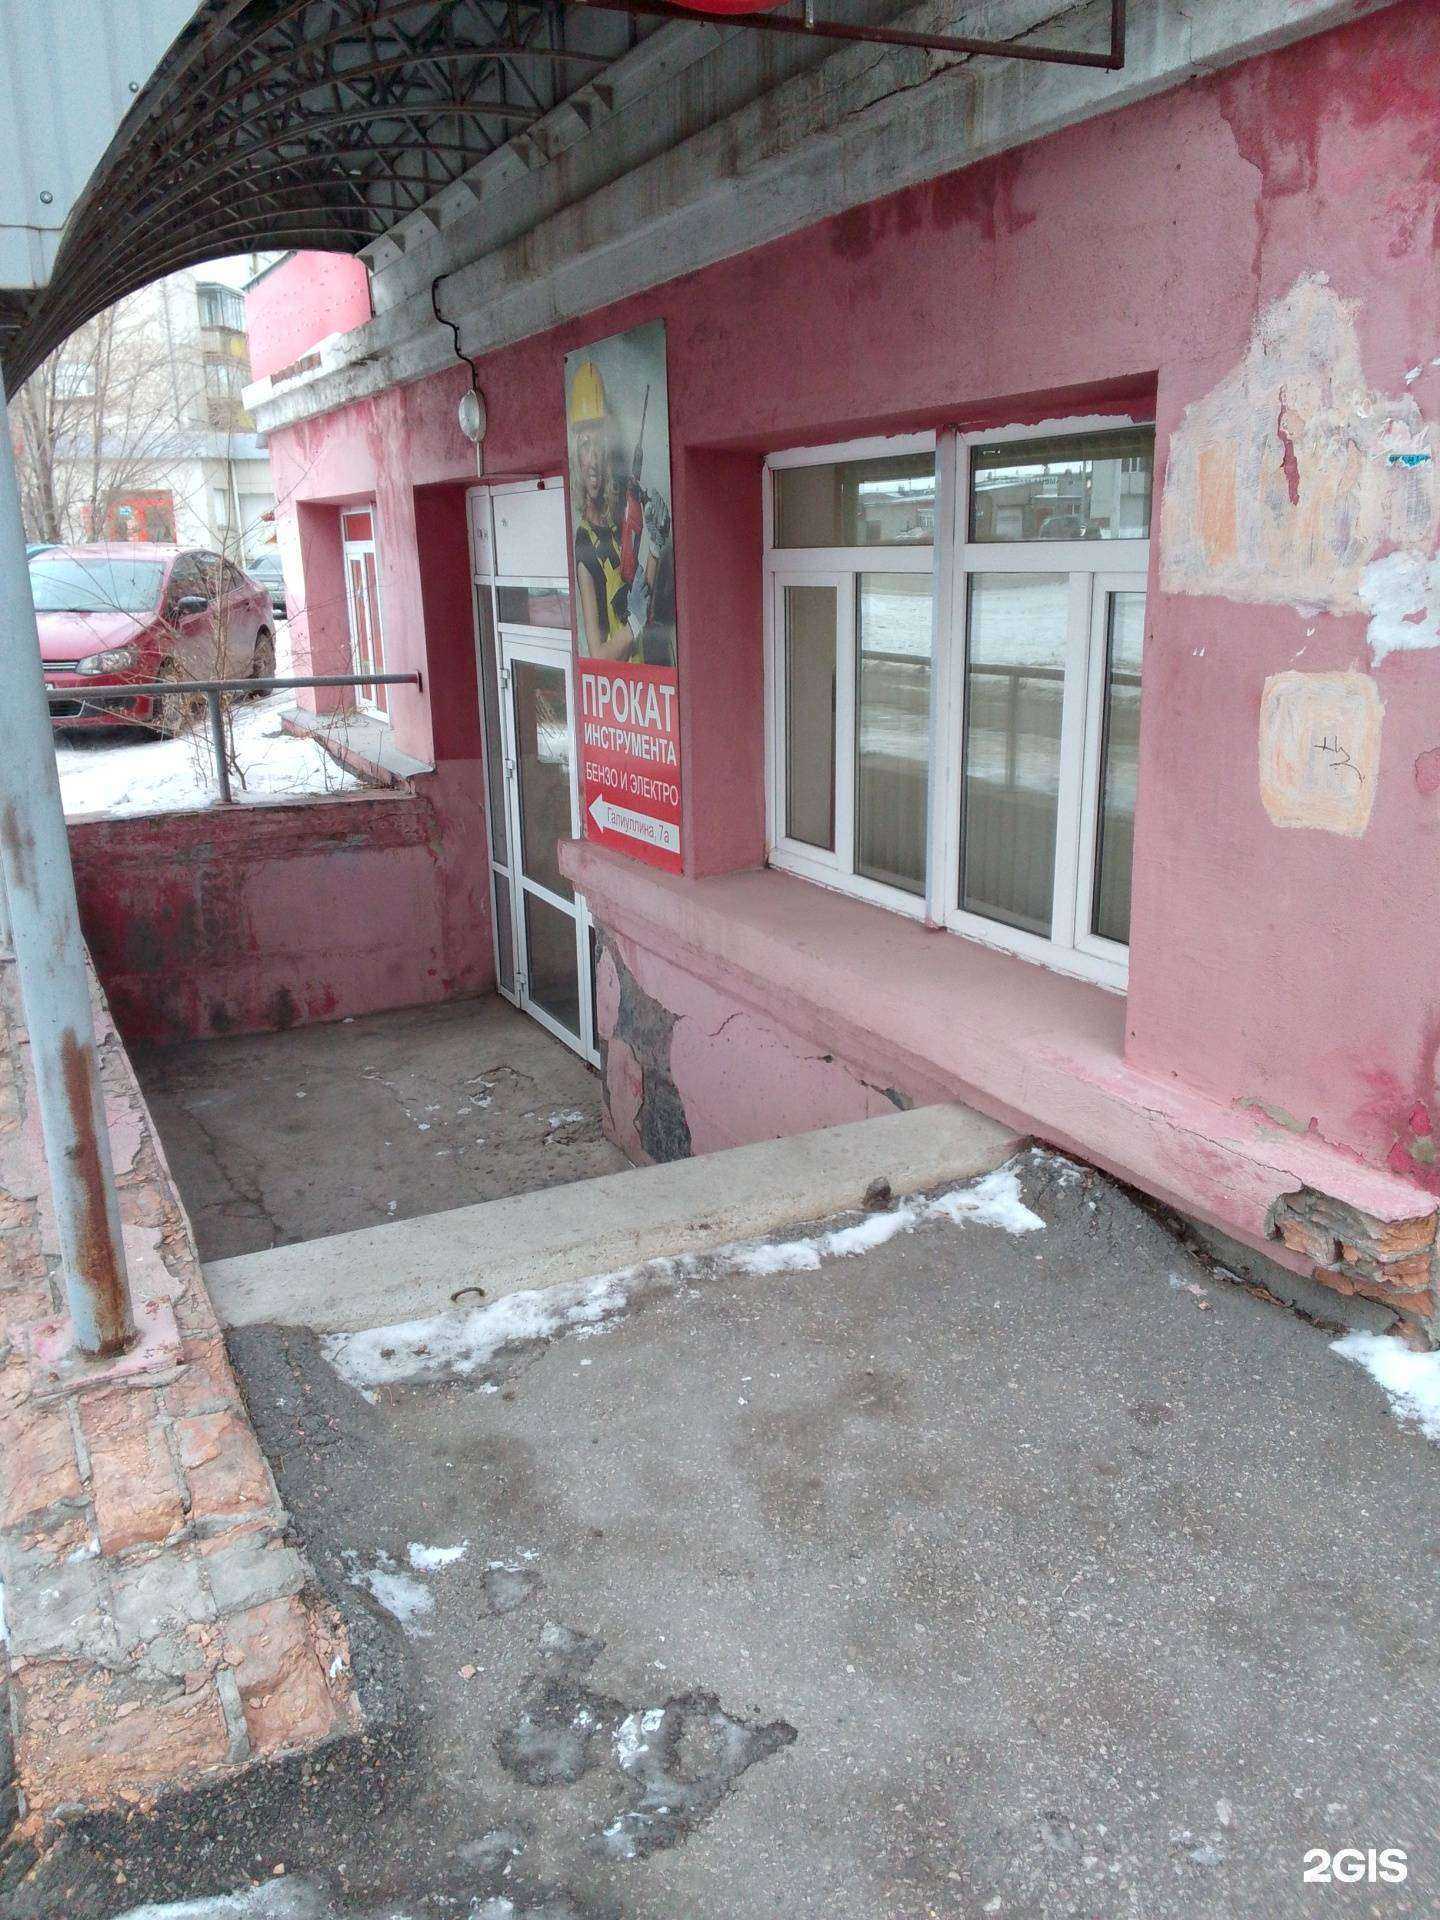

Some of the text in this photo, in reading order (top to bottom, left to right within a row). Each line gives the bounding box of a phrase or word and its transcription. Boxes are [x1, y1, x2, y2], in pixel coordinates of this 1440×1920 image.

[581, 673, 675, 732] ПРОКАТ
[584, 722, 677, 766] ИНСТРУМЕНТА
[585, 762, 679, 806] БЕНЗО И ЭЛЕКТРО
[607, 806, 670, 843] Галиуллина, 7а
